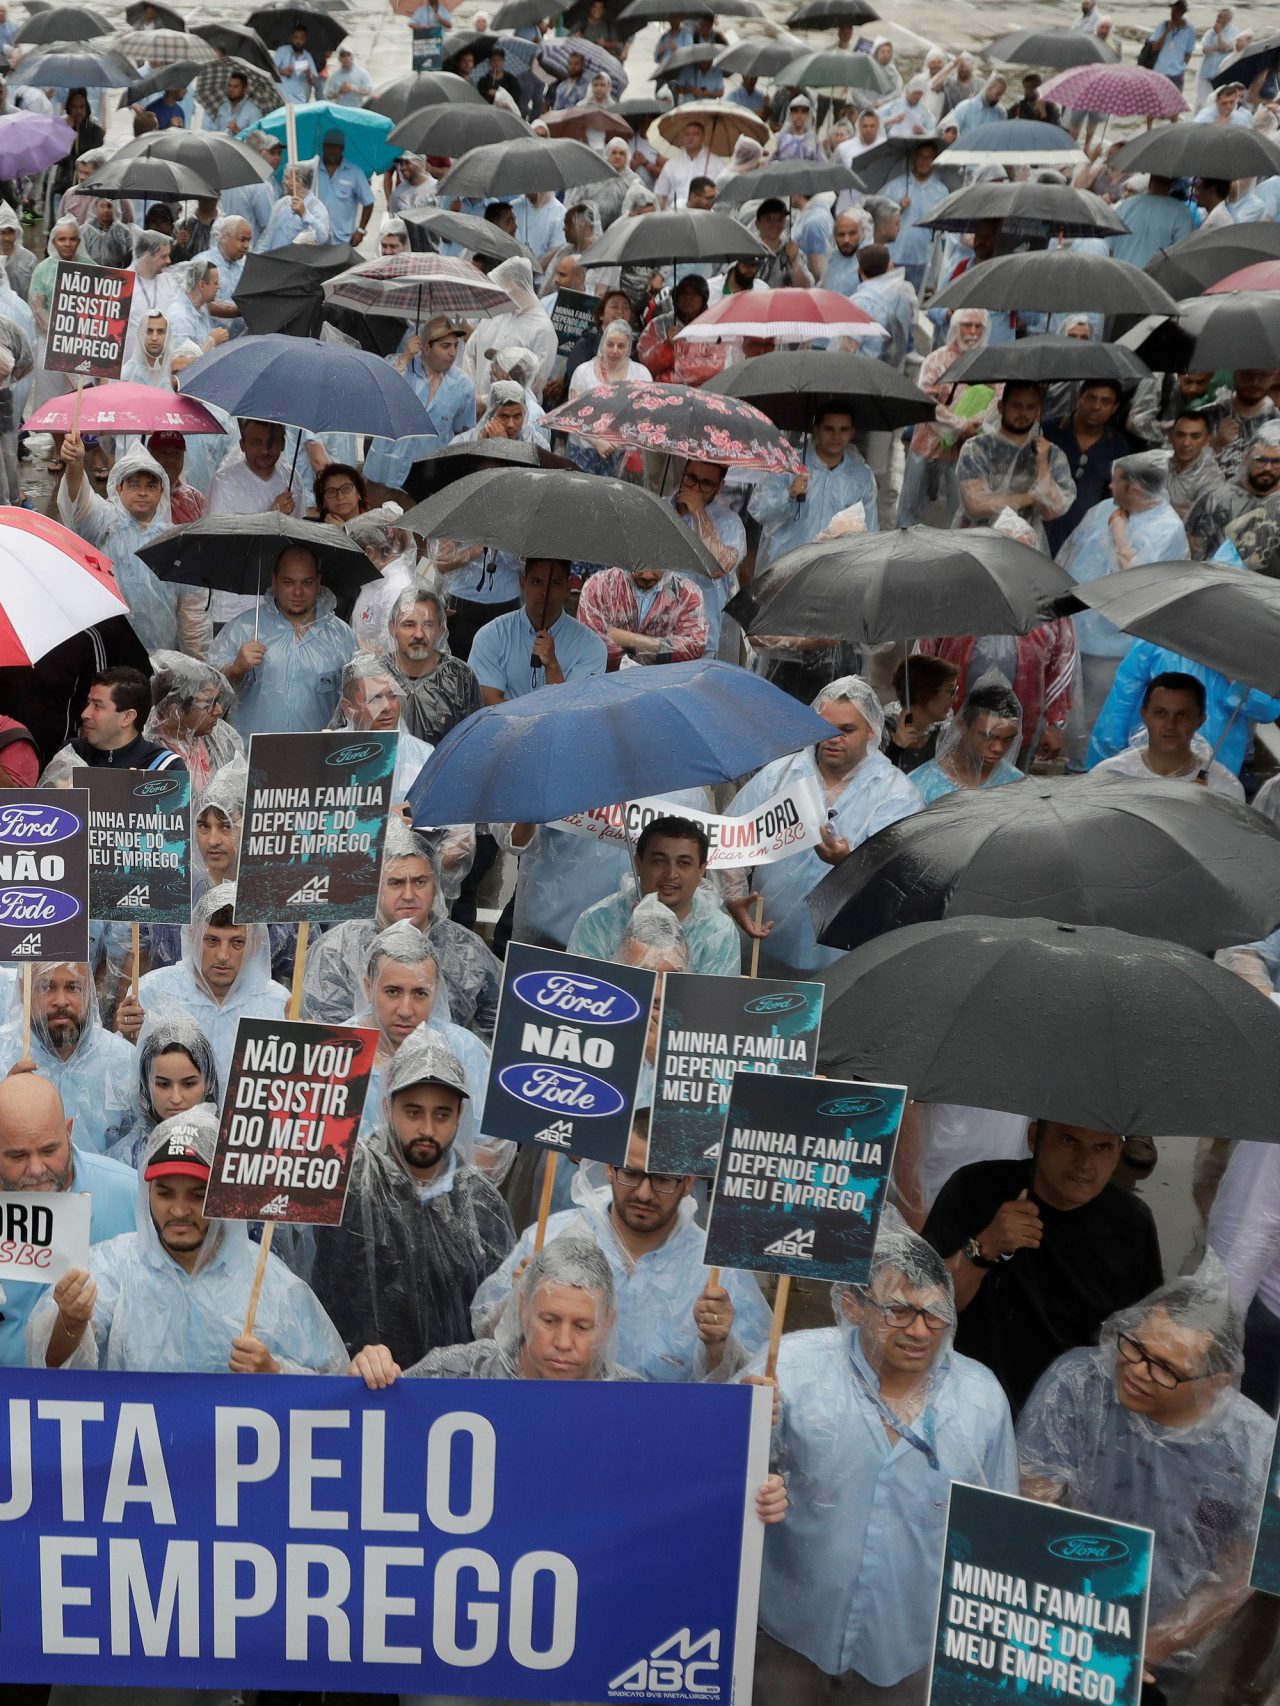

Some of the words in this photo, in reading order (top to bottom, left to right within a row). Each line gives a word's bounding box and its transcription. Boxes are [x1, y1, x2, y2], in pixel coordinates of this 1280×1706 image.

[60, 271, 90, 294] NÃO
[94, 277, 122, 298] VOU
[58, 293, 121, 319] DESISTIR
[55, 314, 74, 333] DO
[77, 317, 108, 338] MEU
[52, 334, 119, 360] EMPREGO
[336, 746, 371, 764] Ford
[254, 787, 310, 809] MINHA
[315, 783, 383, 807] FAMÍLIA
[128, 810, 184, 831] FAMÍLIA
[251, 811, 328, 833] DEPENDE
[333, 810, 357, 830] DO
[89, 830, 142, 848] EPENDE
[146, 833, 164, 849] DO
[248, 835, 286, 856] MEU
[290, 833, 371, 855] EMPREGO
[748, 847, 769, 858] em
[772, 823, 806, 851] SBC
[114, 850, 179, 869] EMPREGO
[536, 976, 617, 1017] Ford
[755, 997, 791, 1011] Ford
[242, 1034, 297, 1074] NÃO
[303, 1043, 354, 1079] VOU
[521, 1022, 615, 1069] NÃO
[667, 1030, 728, 1055] MINHA
[732, 1034, 807, 1061] FAMÍLIA
[235, 1077, 349, 1116] DESISTIR
[522, 1068, 596, 1109] Fode
[663, 1080, 703, 1102] MEU
[828, 1099, 868, 1113] Ford
[169, 1135, 194, 1146] SILV
[228, 1114, 265, 1148] DO
[267, 1117, 326, 1152] MEU
[731, 1127, 797, 1156] MINHA
[802, 1136, 882, 1165] FAMÍLIA
[168, 1145, 184, 1156] ER
[221, 1152, 341, 1190] EMPREGO
[728, 1152, 819, 1182] DEPENDE
[822, 1162, 851, 1186] DO
[723, 1175, 768, 1200] MEU
[771, 1181, 866, 1212] EMPREGO
[215, 1406, 497, 1535] PELO
[1063, 1539, 1111, 1557] Ford
[39, 1535, 579, 1670] EMPREGO
[951, 1560, 1028, 1609] MINHA
[1034, 1582, 1131, 1639] FAMÍLIA
[948, 1594, 1055, 1651] DEPENDE
[1060, 1625, 1093, 1662] DO
[945, 1628, 996, 1669] MEU
[1000, 1644, 1116, 1705] EMPREGO
